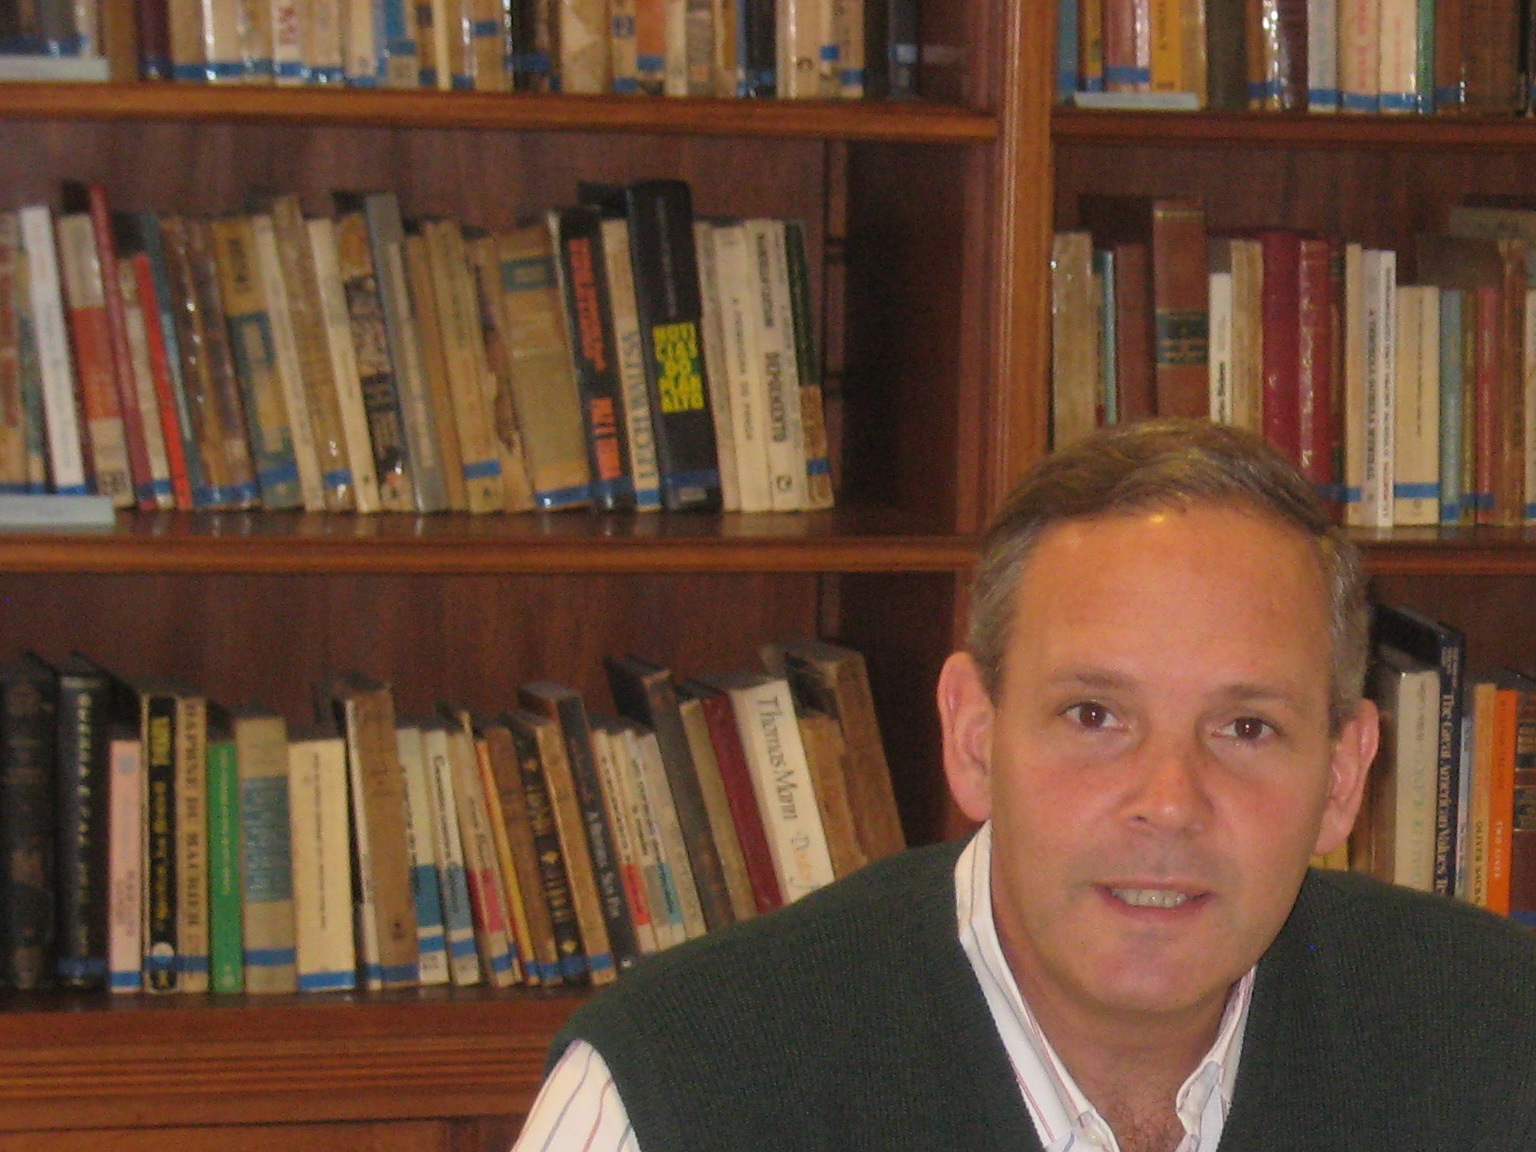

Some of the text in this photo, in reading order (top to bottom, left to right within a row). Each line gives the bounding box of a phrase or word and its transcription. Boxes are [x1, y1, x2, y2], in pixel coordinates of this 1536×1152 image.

[758, 695, 799, 820] Thomas Mann
[1440, 720, 1454, 759] Great
[1437, 760, 1453, 826] American
[1436, 827, 1450, 873] Values
